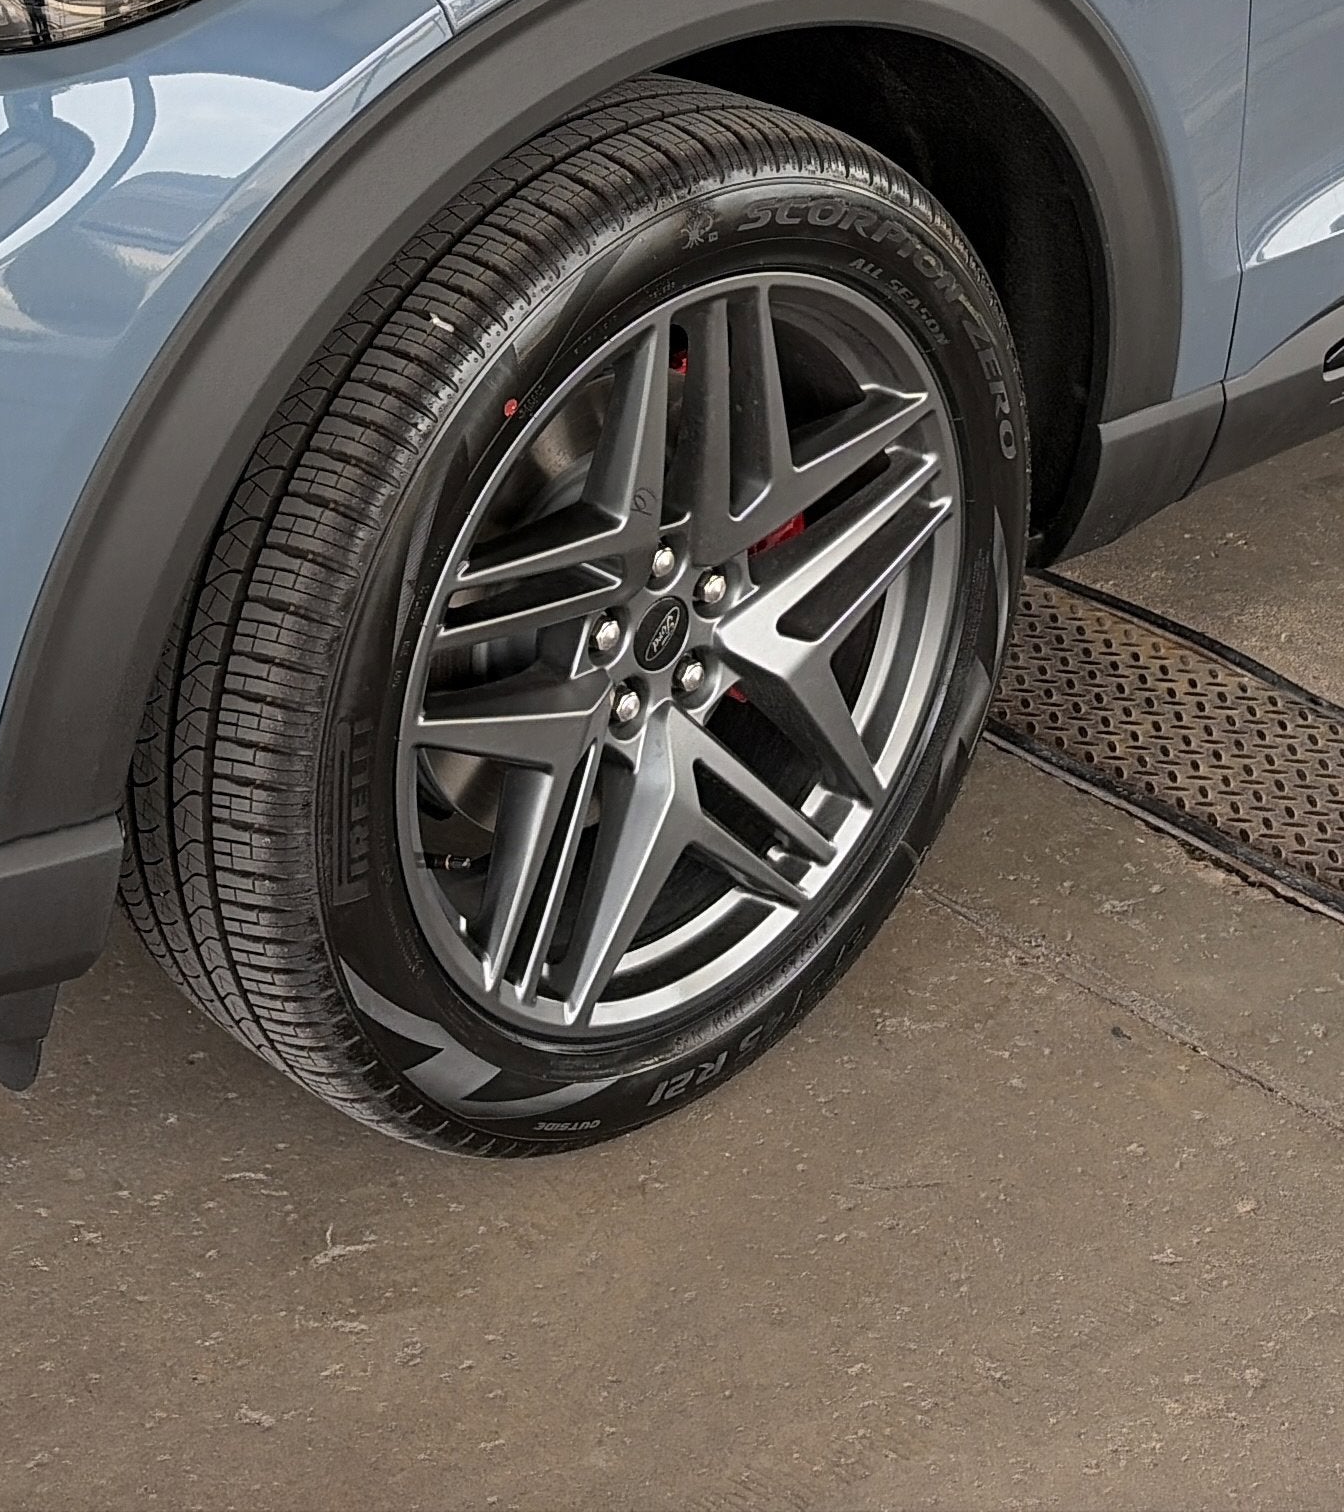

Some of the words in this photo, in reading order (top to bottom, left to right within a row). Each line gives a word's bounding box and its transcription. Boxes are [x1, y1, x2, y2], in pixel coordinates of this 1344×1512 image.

[737, 197, 965, 304] SCORPION
[960, 316, 1018, 460] ZERO
[850, 256, 885, 281] ALL
[888, 277, 952, 346] SEASON
[652, 615, 675, 653] Ford
[332, 717, 374, 906] PIRELLI
[646, 1050, 729, 1107] R21
[533, 1119, 601, 1132] OUTSIDE
